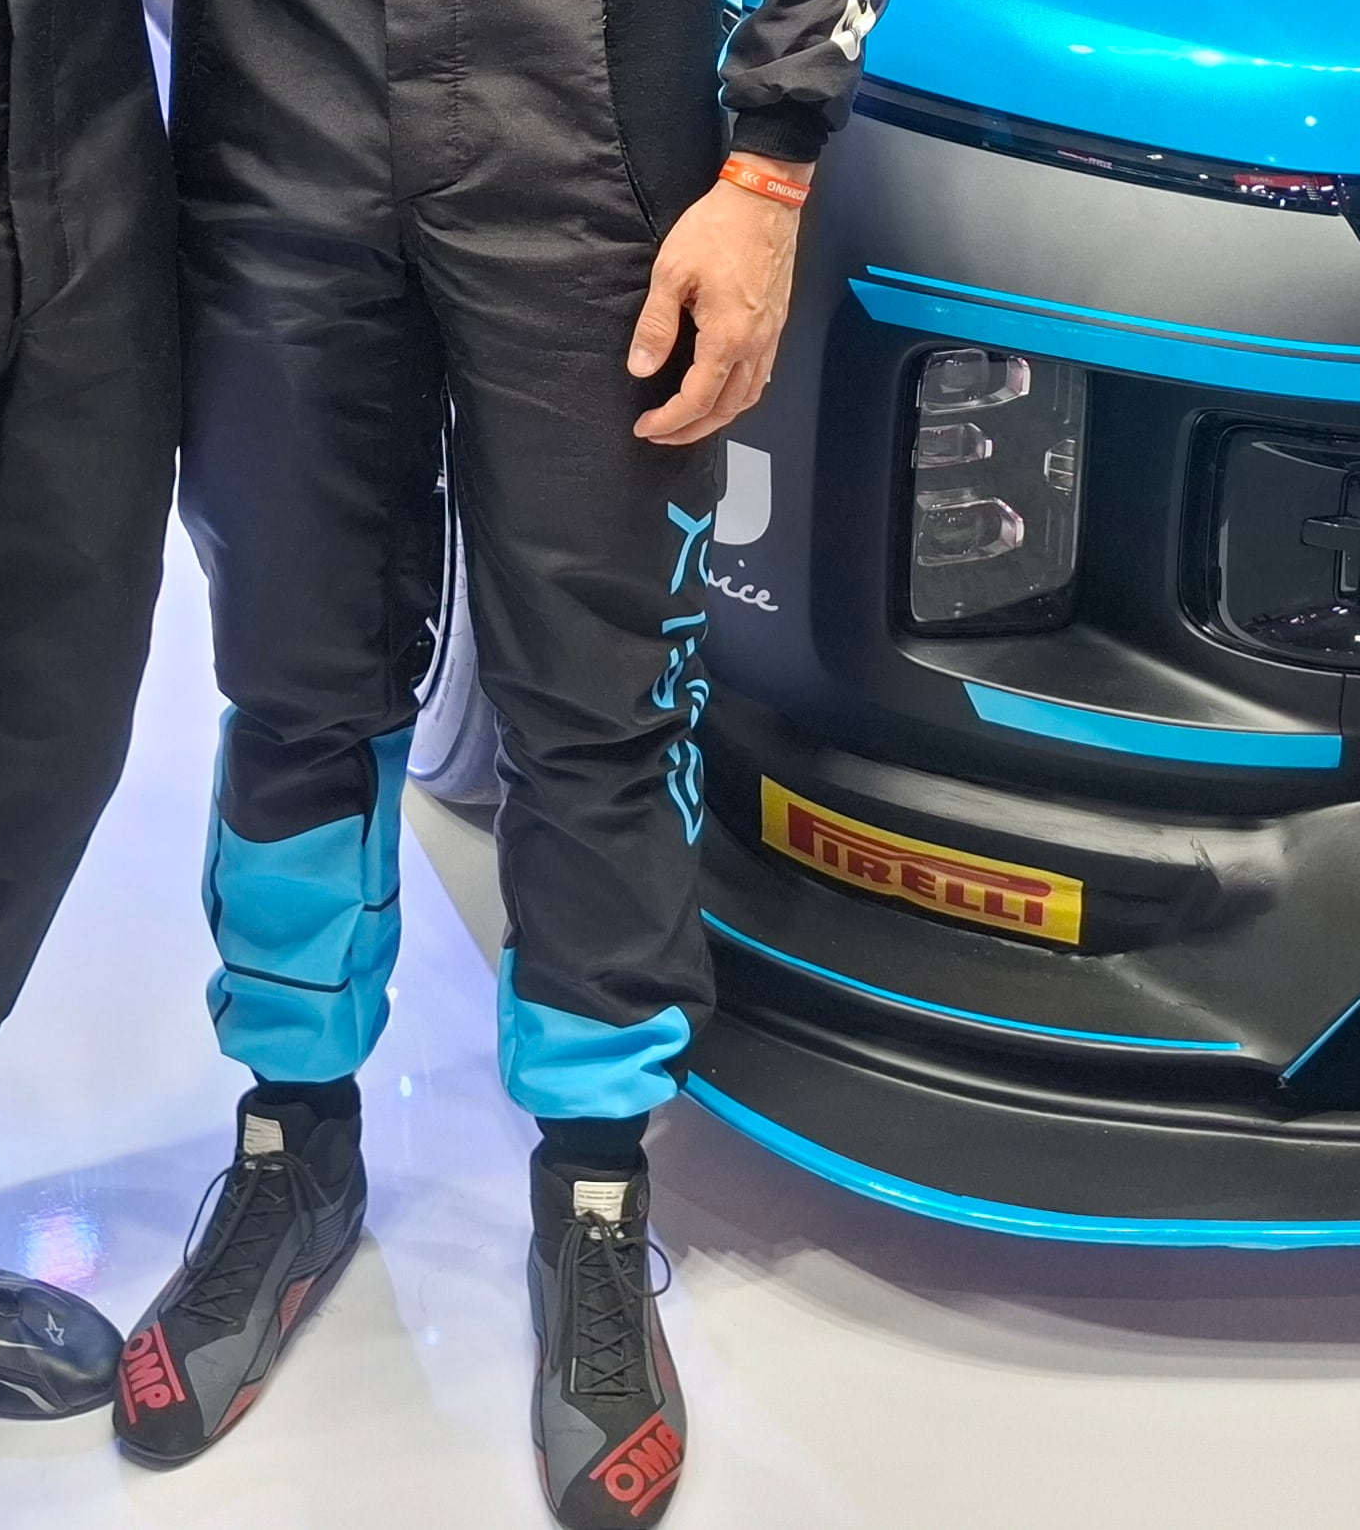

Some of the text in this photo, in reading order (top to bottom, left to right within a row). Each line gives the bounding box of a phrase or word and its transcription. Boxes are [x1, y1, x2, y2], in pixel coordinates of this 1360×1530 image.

[787, 801, 1052, 927] PIRELLI
[123, 1330, 172, 1409] OMP
[605, 1424, 682, 1502] OMP
